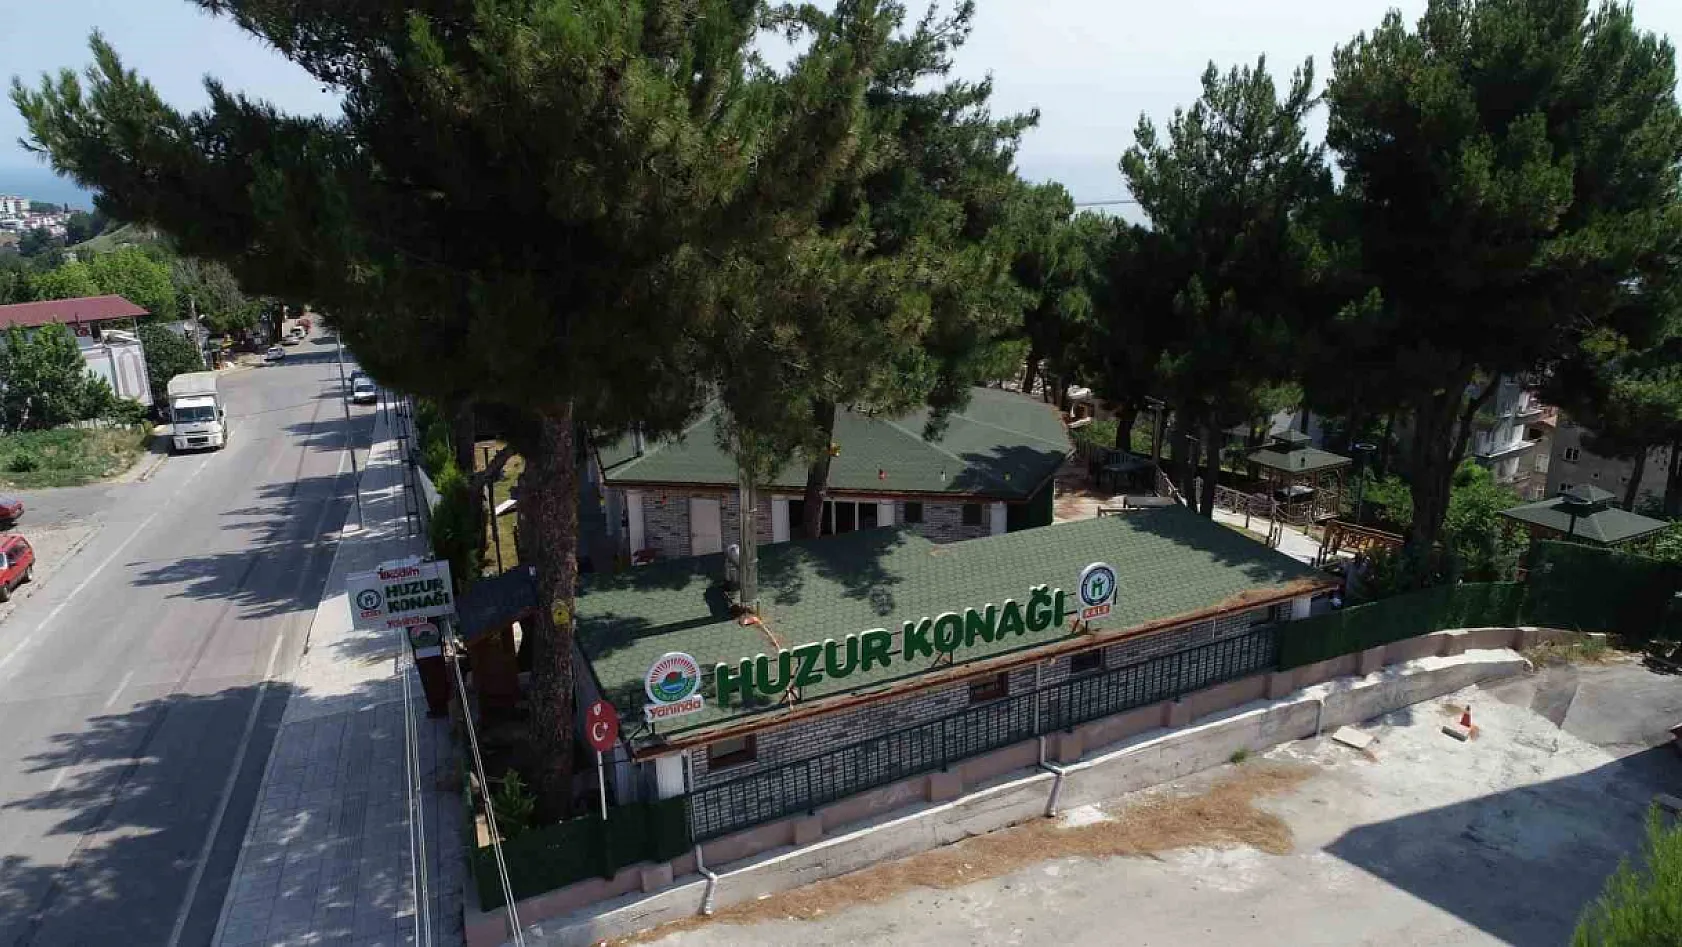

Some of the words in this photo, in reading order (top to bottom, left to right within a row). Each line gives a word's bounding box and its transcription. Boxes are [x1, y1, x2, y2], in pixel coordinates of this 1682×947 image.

[385, 578, 445, 598] HUZUR
[387, 591, 451, 613] KONAĞI
[714, 628, 892, 708] HUZUR
[902, 583, 1065, 662] KONAĞI
